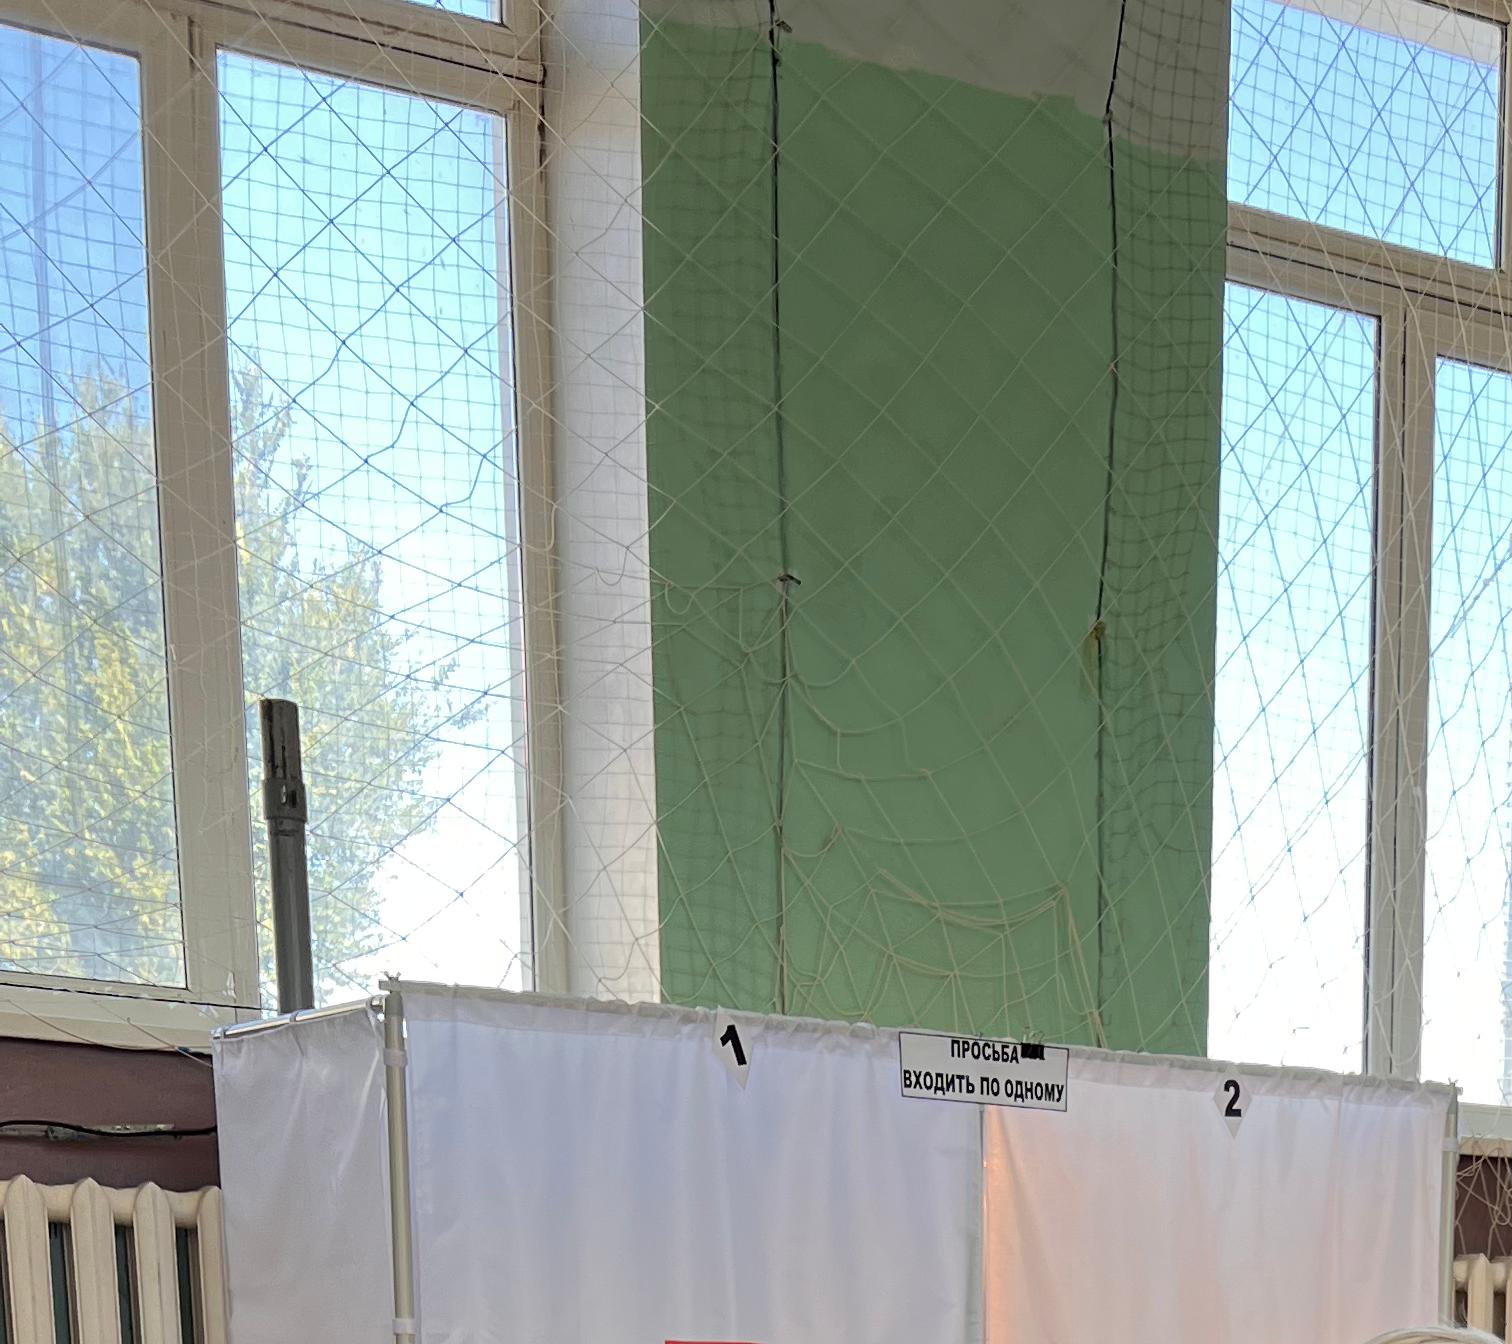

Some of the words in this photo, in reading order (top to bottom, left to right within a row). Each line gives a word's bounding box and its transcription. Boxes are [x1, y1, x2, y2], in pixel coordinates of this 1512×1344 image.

[720, 1024, 747, 1066] 1
[951, 1039, 1019, 1064] ПРОСЬБА
[903, 1069, 975, 1096] ВХОДИТЬ
[980, 1076, 1000, 1097] ПО
[1004, 1078, 1064, 1103] ОДНОМУ
[1223, 1079, 1242, 1117] 2
